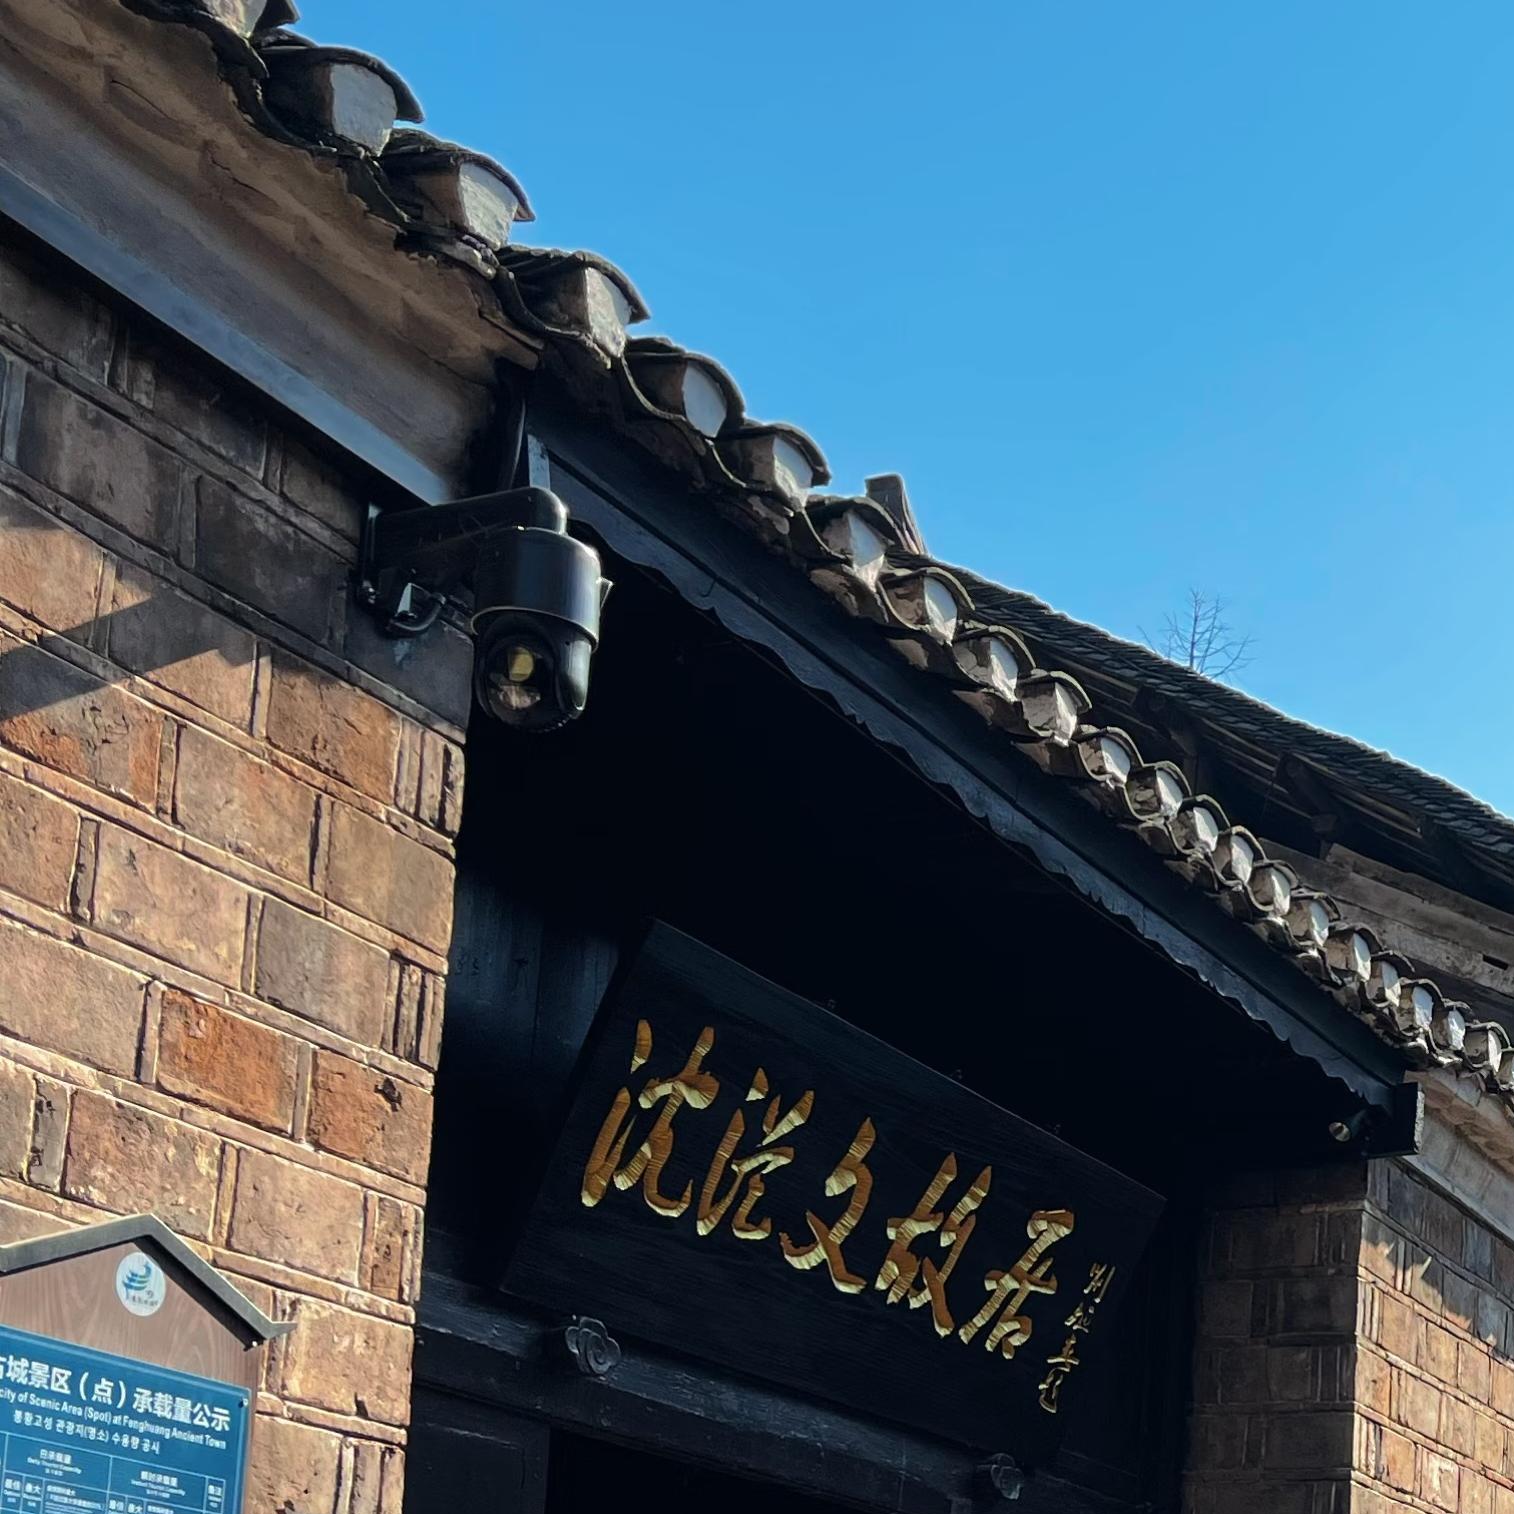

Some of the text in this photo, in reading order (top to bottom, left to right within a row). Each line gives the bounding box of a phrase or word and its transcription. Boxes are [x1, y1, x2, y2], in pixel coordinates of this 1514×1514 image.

[18, 1391, 28, 1402] of
[29, 1394, 60, 1411] Scenic
[61, 1400, 83, 1417] Area
[84, 1406, 112, 1425] (Spot)
[113, 1414, 123, 1424] at
[123, 1416, 171, 1439] Fenghuang
[172, 1427, 204, 1445] Ancient
[205, 1435, 227, 1450] Town
